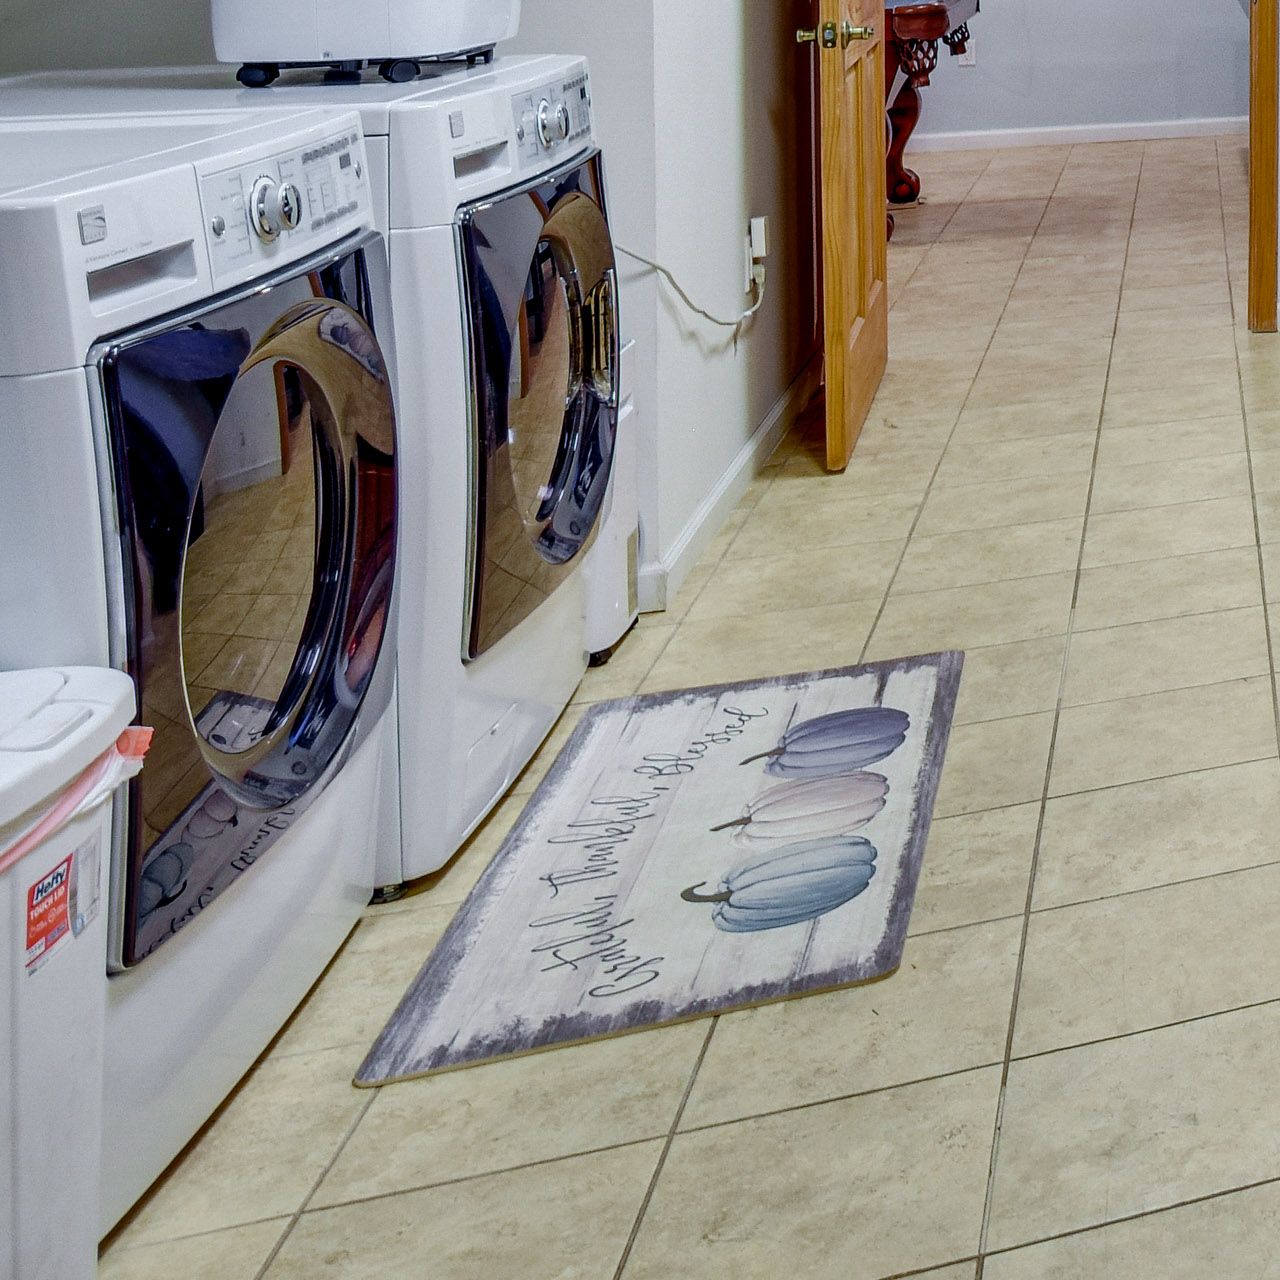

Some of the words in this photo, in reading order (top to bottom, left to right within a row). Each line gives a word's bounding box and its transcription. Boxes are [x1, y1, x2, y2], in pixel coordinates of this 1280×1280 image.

[633, 706, 769, 780] Blessed
[539, 787, 670, 899] Thankful,
[30, 894, 52, 920] TOUCH
[34, 868, 66, 901] Hefty
[529, 894, 665, 997] Grateful,
